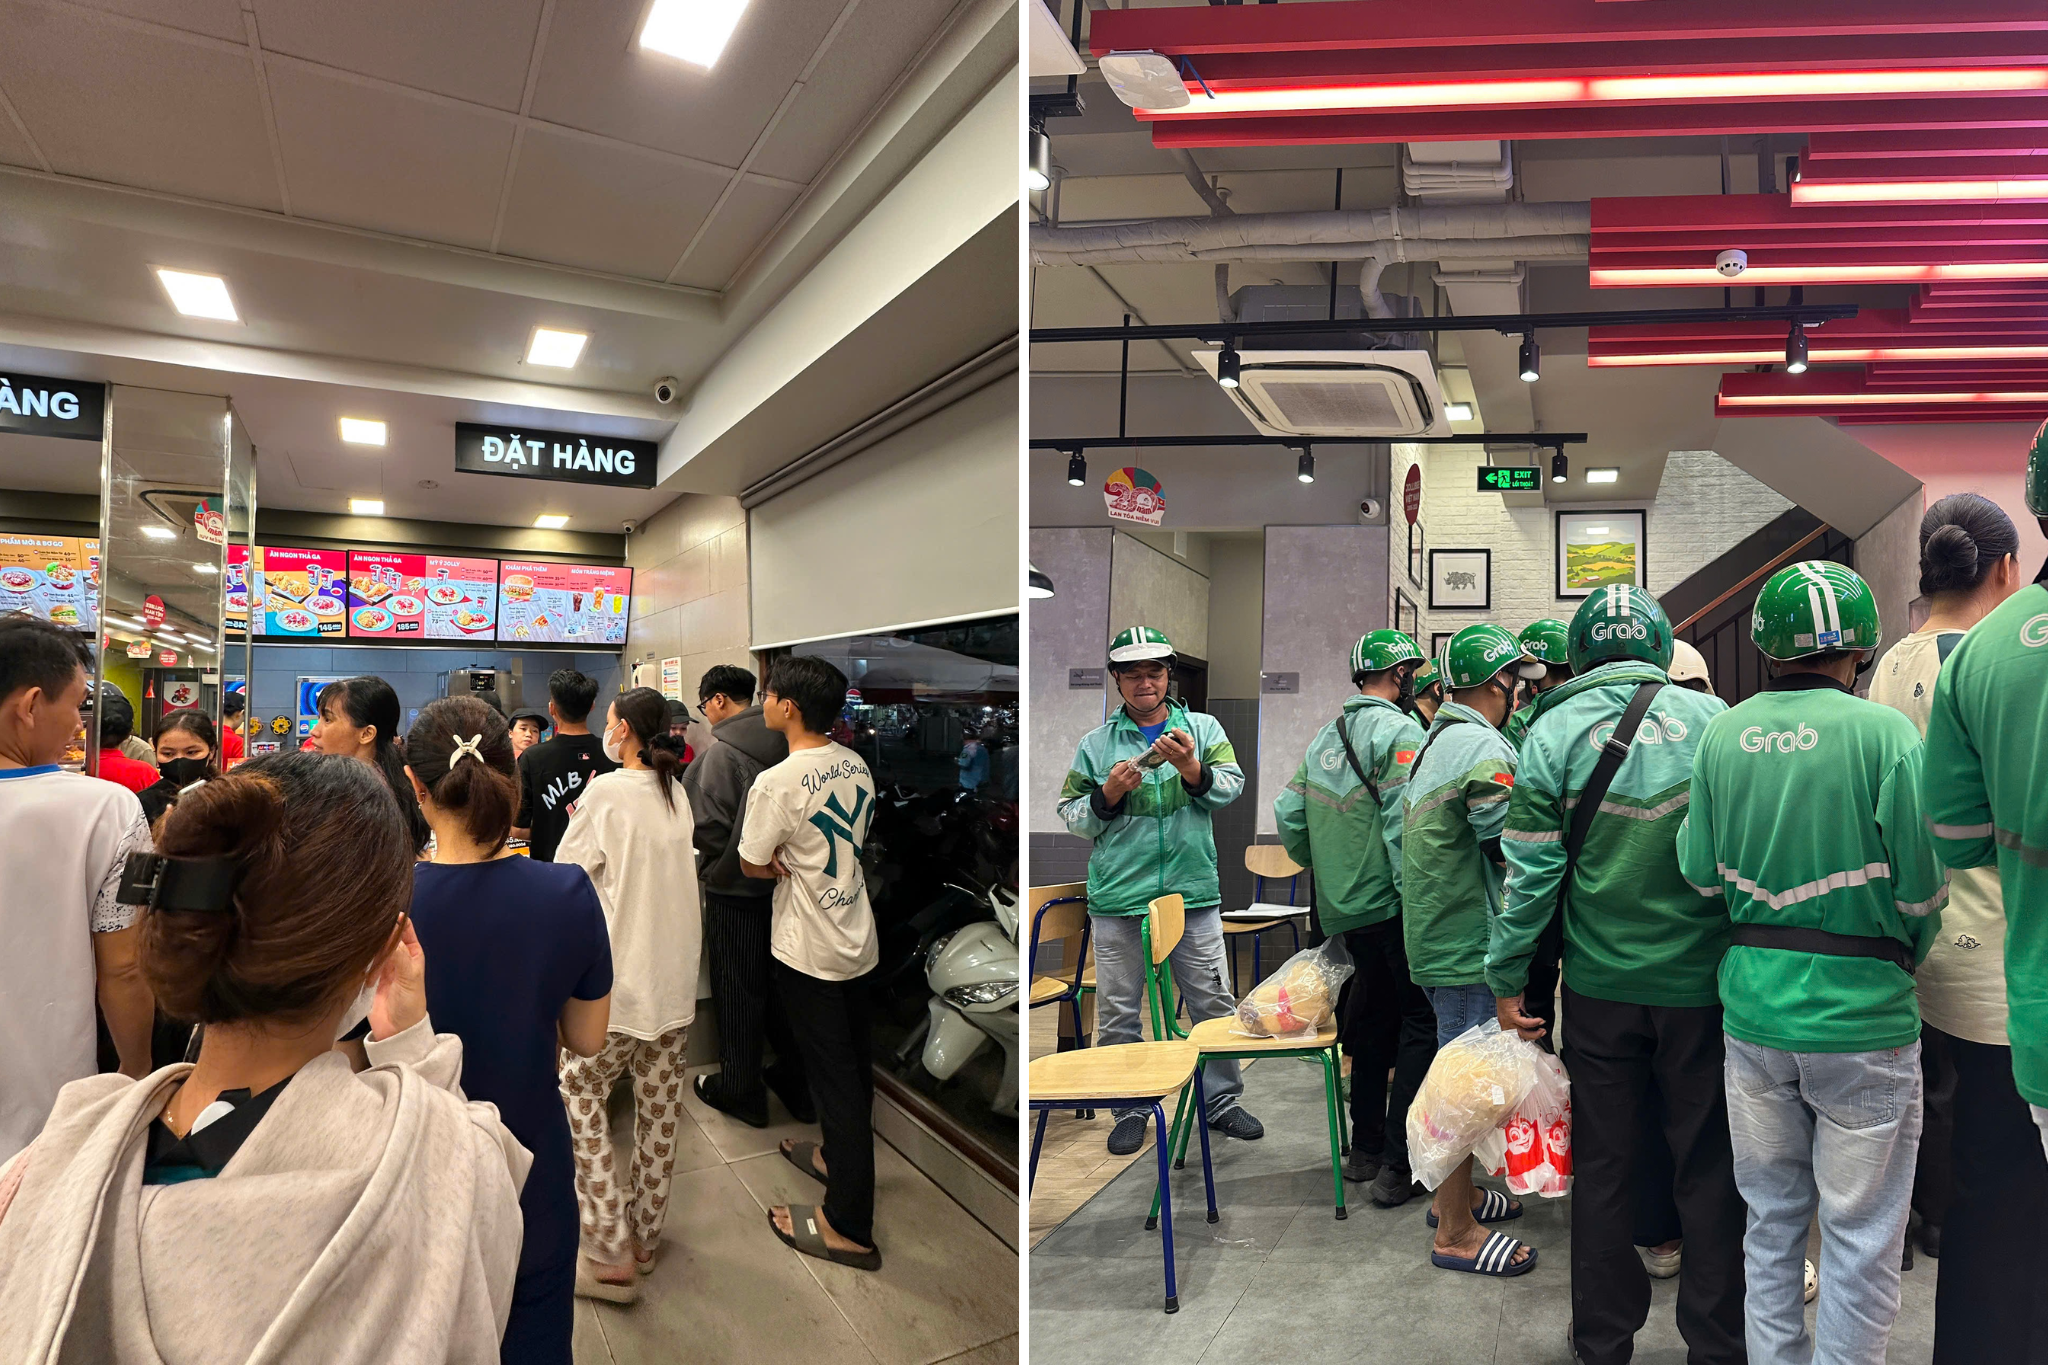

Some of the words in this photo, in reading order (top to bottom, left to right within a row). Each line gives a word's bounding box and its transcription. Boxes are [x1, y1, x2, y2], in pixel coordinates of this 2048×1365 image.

[482, 433, 545, 470] ĐẶT
[553, 439, 635, 475] HÀNG
[1514, 471, 1532, 479] EXIT
[1522, 639, 1548, 651] Grab
[1591, 617, 1647, 641] Grab
[1483, 638, 1513, 662] Grab
[1589, 711, 1688, 752] Gab
[1739, 721, 1818, 753] Grab
[541, 771, 582, 810] MLB
[802, 764, 841, 795] World
[842, 760, 870, 779] Series
